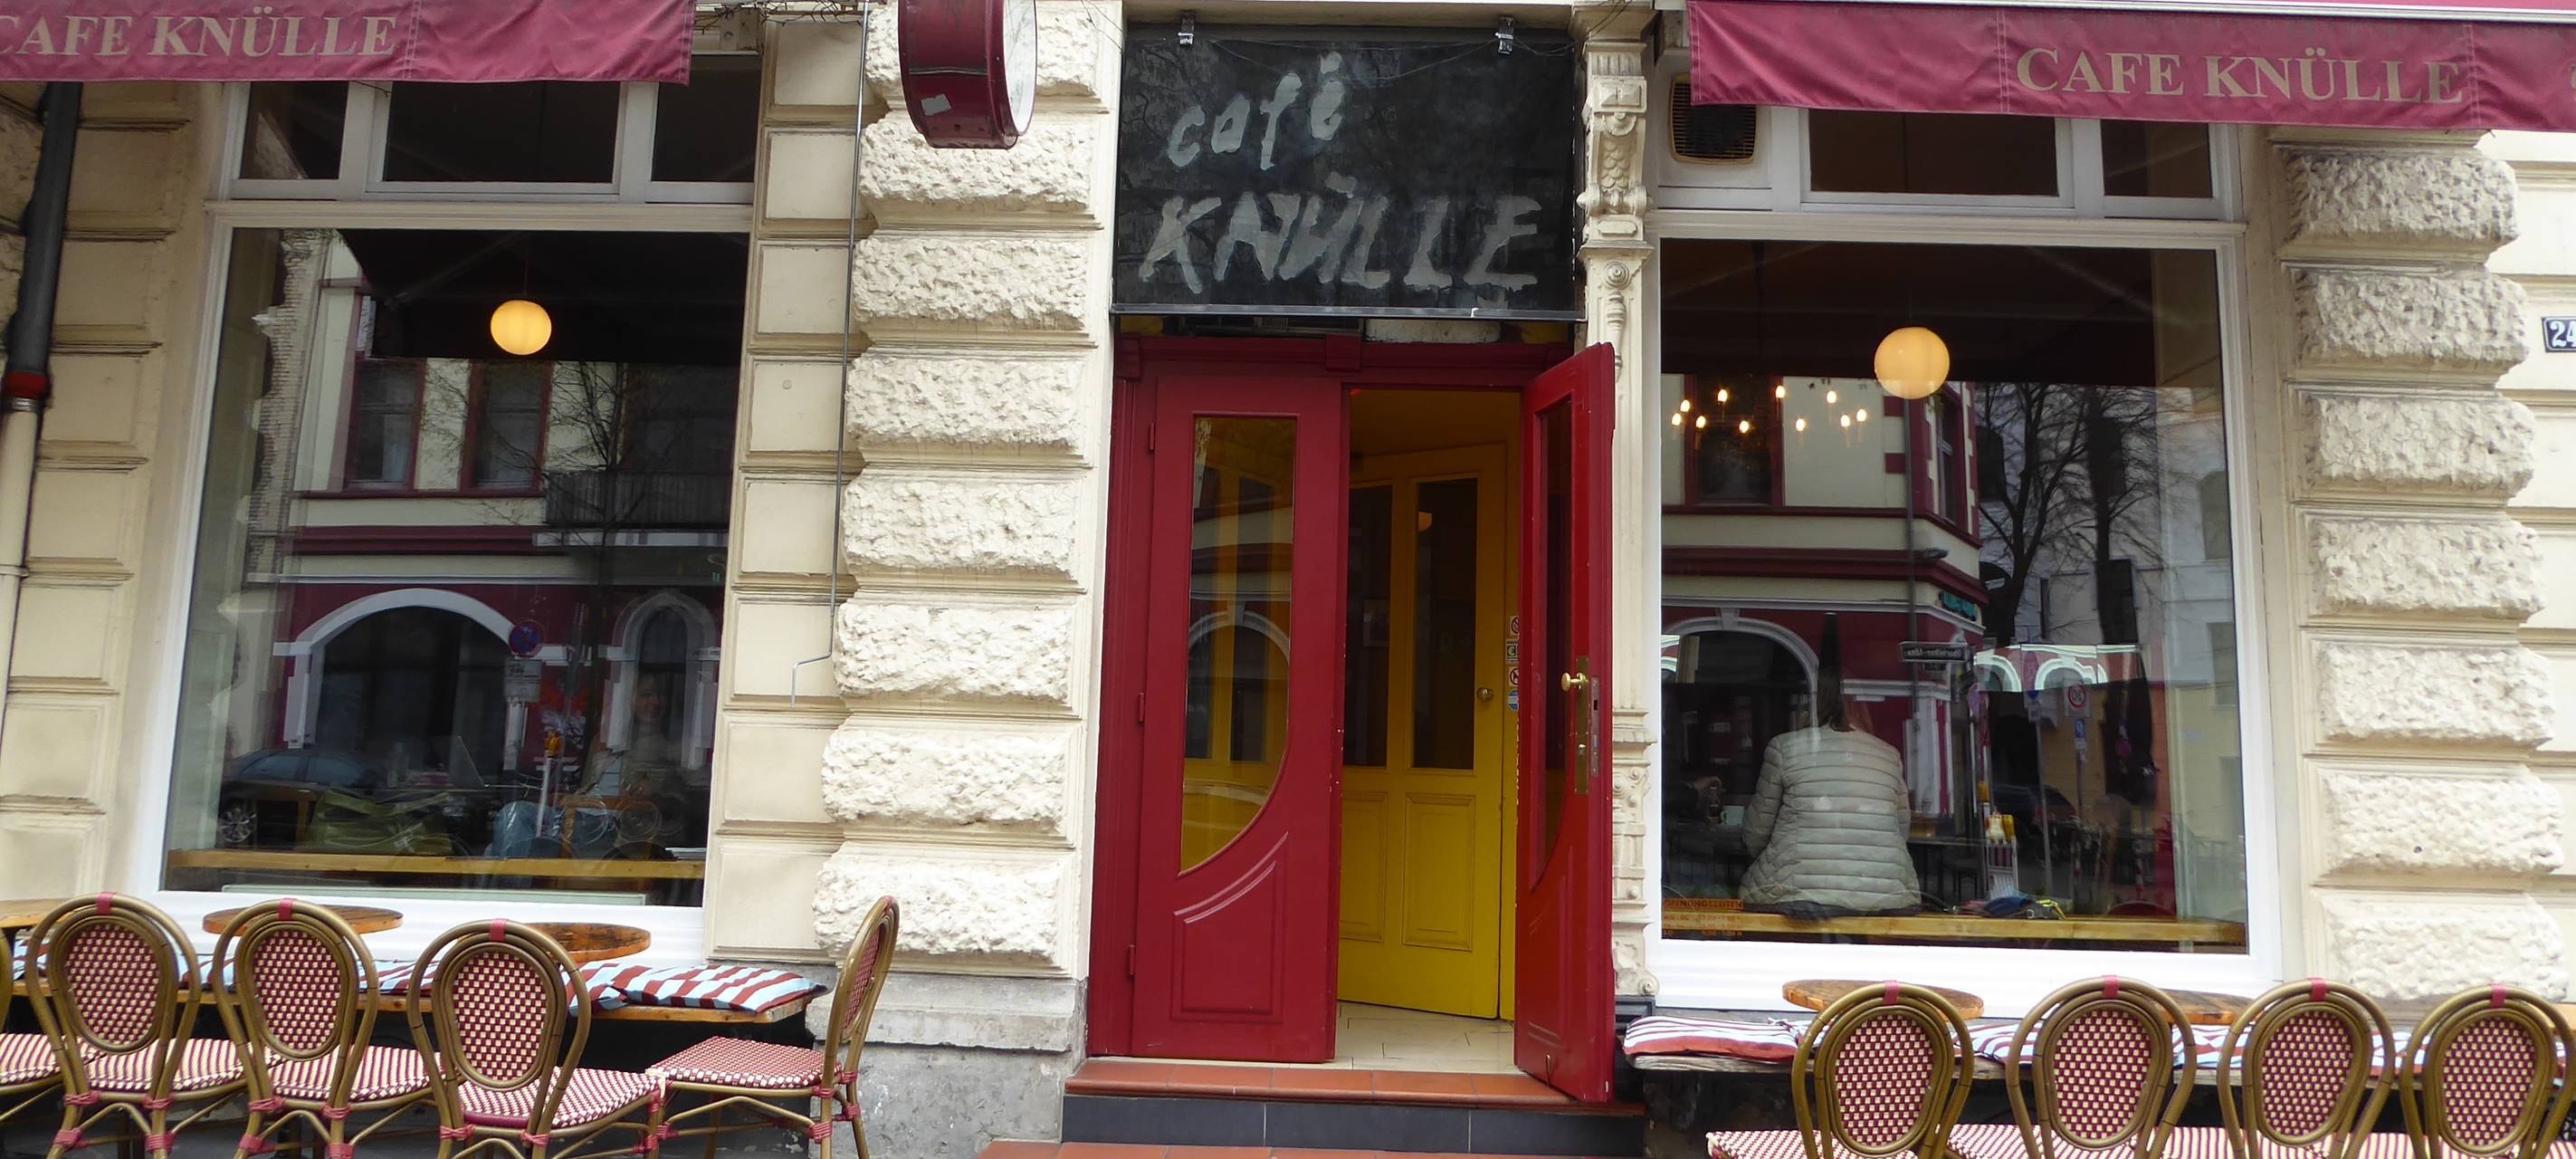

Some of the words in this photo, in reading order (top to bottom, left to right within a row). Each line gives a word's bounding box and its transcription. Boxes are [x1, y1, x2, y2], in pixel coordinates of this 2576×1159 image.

[148, 5, 398, 58] KNÜLLE
[2016, 47, 2185, 96] CAFE
[2201, 47, 2465, 104] KNÜLLE
